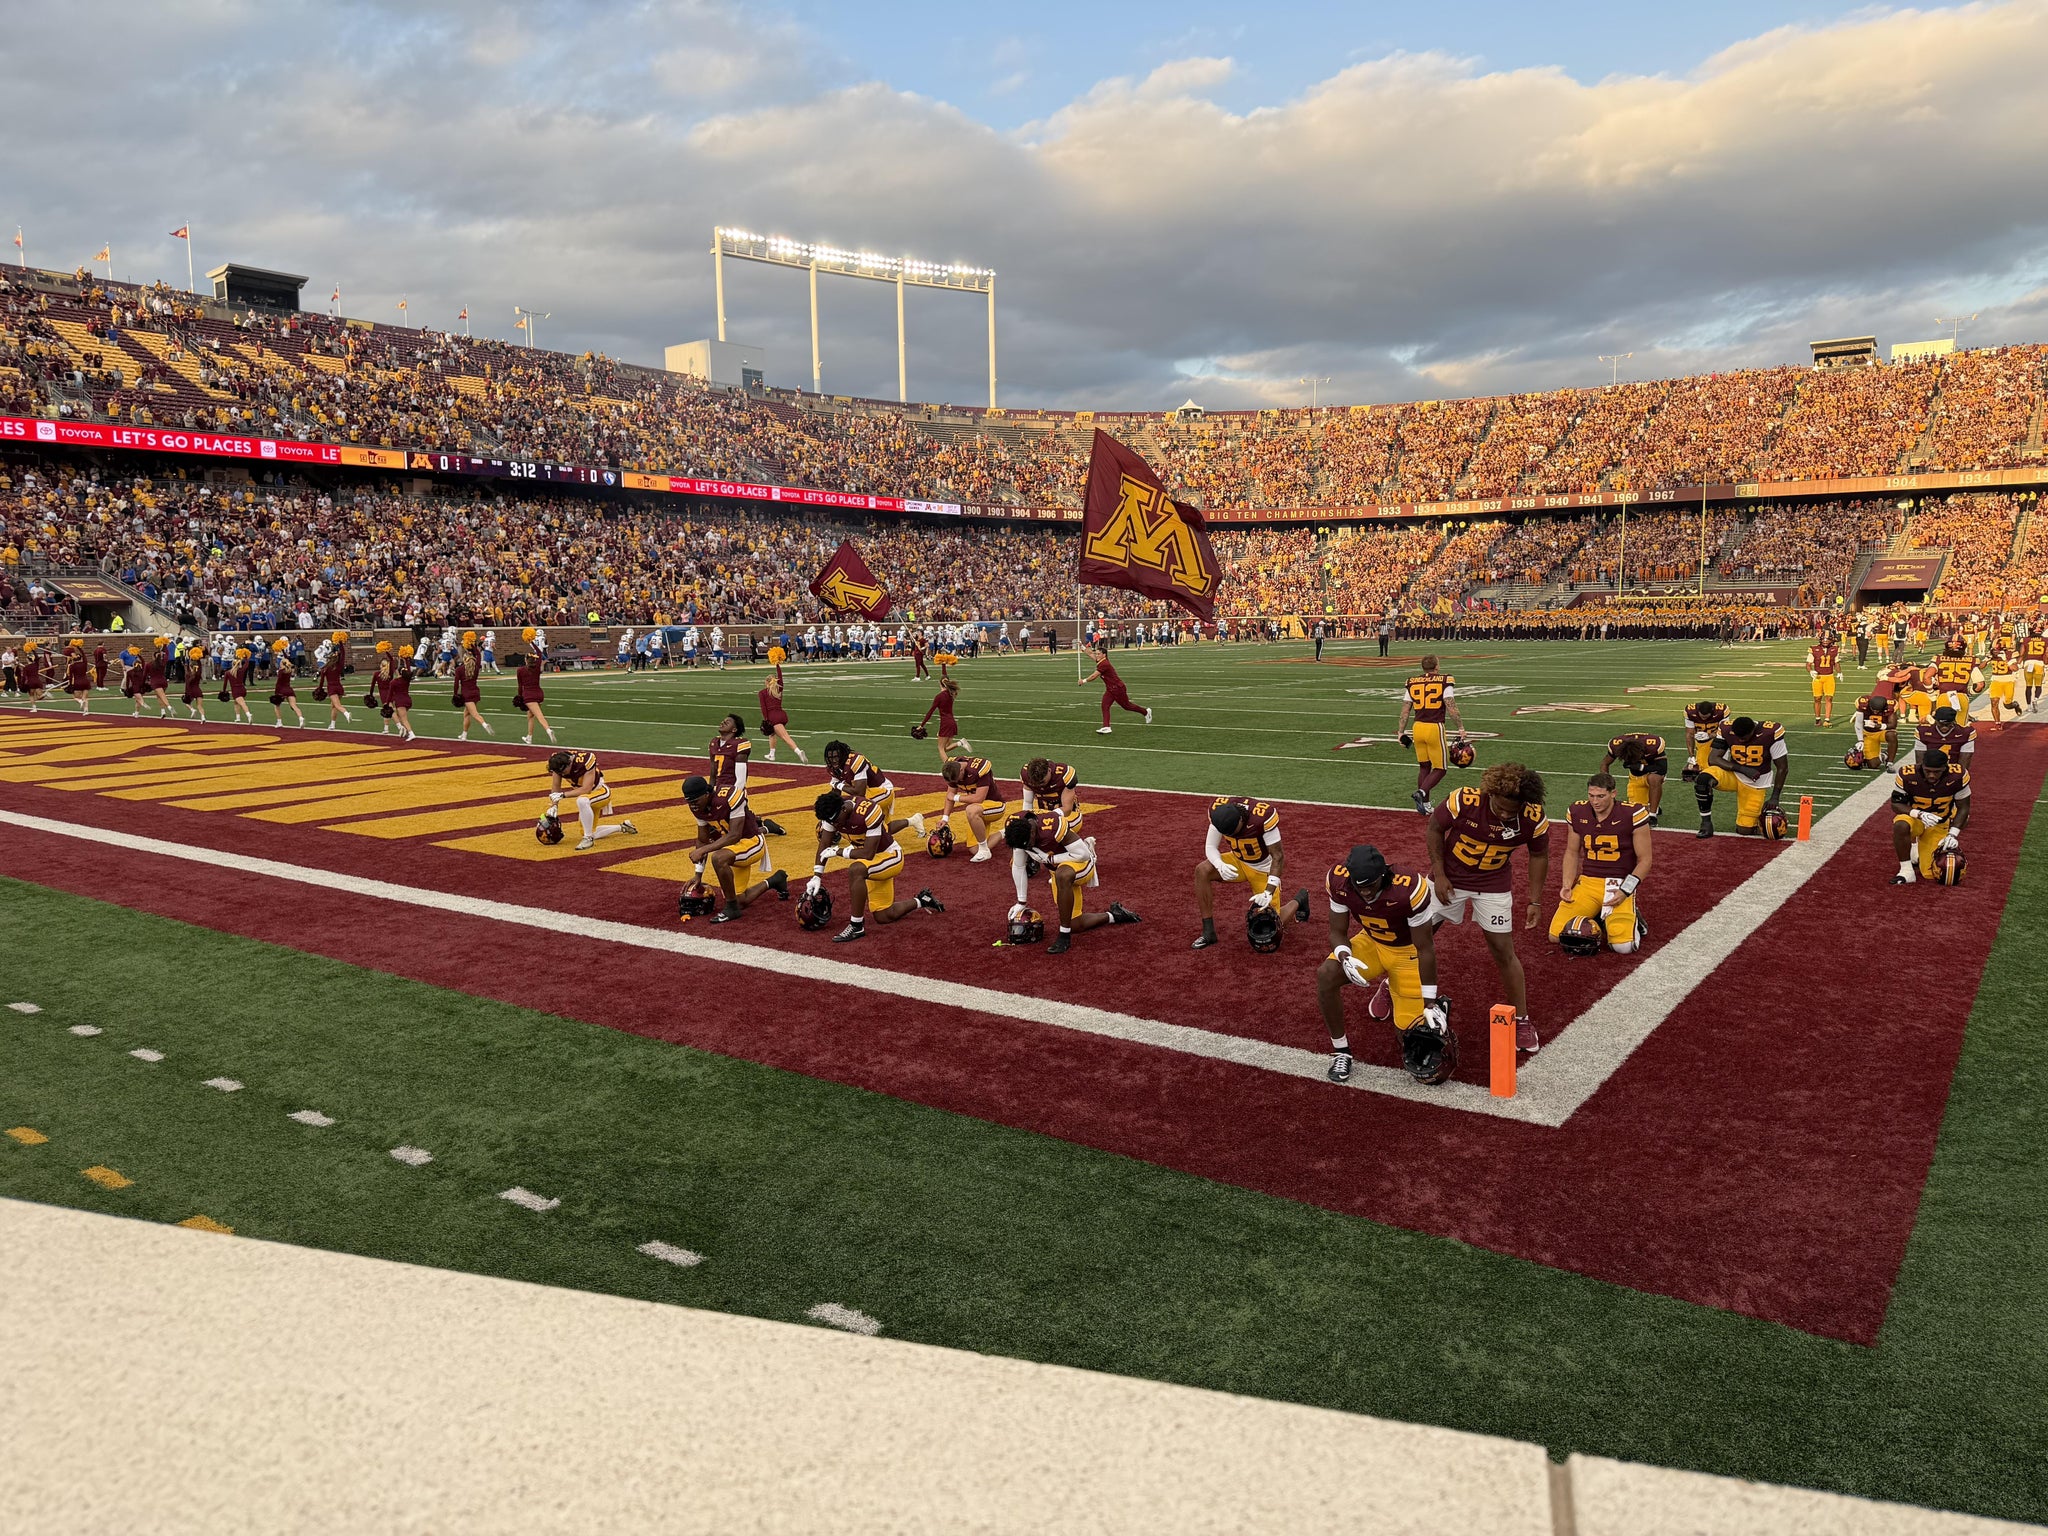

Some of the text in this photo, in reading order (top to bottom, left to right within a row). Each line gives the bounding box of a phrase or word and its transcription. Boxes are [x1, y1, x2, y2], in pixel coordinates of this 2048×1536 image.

[0, 422, 25, 436] ES
[60, 428, 252, 454] TOYOTA LET'S GO PLACES
[279, 446, 340, 460] TOYOTA LE
[440, 456, 448, 470] 0
[510, 462, 537, 478] 3:12
[590, 469, 598, 483] 0
[1886, 477, 1917, 488] 1904
[1958, 473, 1991, 485] 1934
[695, 482, 717, 493] LET'S
[720, 485, 735, 495] GO
[737, 486, 768, 498] PLACES
[782, 490, 865, 506] TOYOTA LET'S GO PLACES
[896, 500, 905, 510] LE
[1378, 490, 1675, 516] 1933 1934 1935 1937 1938 1940 1941 1960 1967
[963, 505, 981, 516] 1900
[987, 506, 1005, 517] 1903
[1011, 507, 1031, 518] 1904
[1037, 508, 1056, 519] 1906
[1063, 510, 1083, 520] 1909
[1209, 508, 1364, 520] BIG TEN CHAMPIONSHIPS
[2027, 641, 2046, 656] 15
[1820, 655, 1831, 668] 11
[1409, 676, 1443, 684] SUNDERLAND
[1938, 661, 1972, 684] 35
[1410, 683, 1443, 710] 92
[1730, 744, 1764, 767] 68
[714, 755, 725, 777] 7
[1902, 764, 1916, 776] 23
[1462, 786, 1481, 807] 26
[1252, 802, 1271, 817] 20
[1041, 817, 1055, 831] 14
[1452, 834, 1517, 871] 26
[1584, 834, 1622, 862] 12
[1391, 873, 1412, 888] 5
[1359, 914, 1398, 942] 5
[1491, 915, 1504, 926] 26
[1492, 1014, 1509, 1026] M
